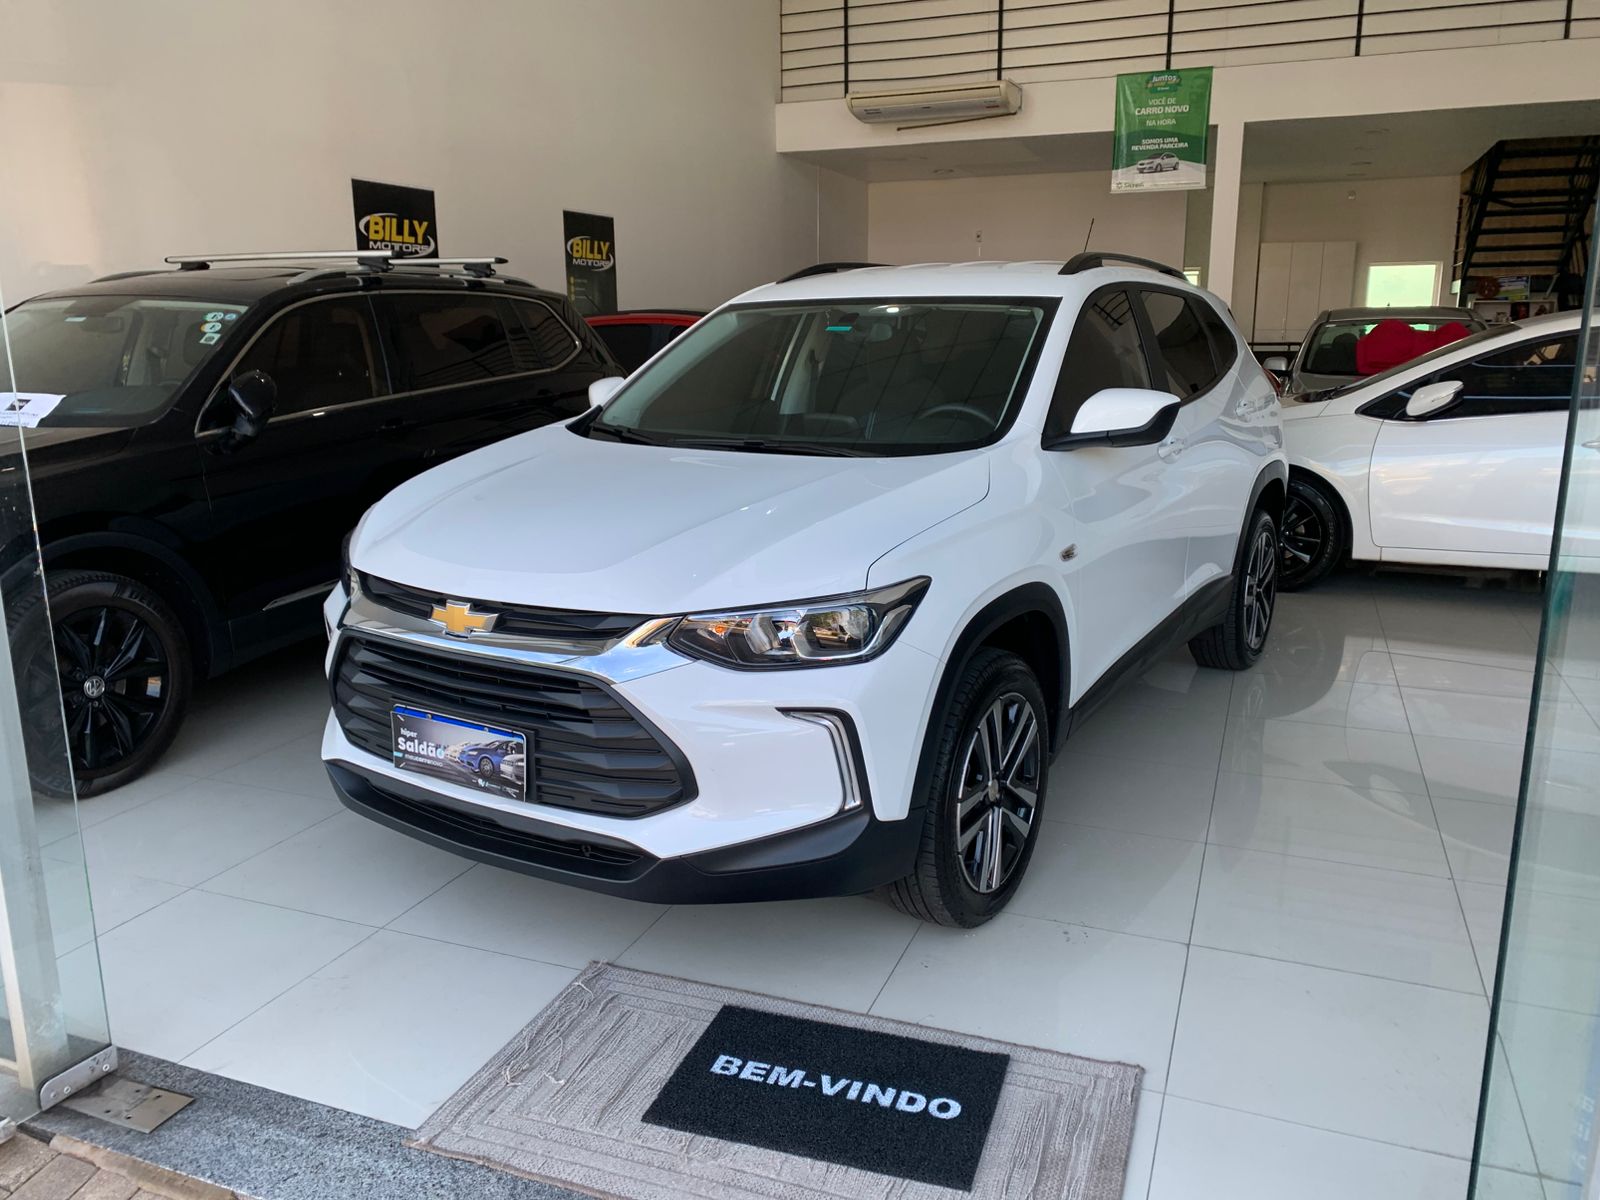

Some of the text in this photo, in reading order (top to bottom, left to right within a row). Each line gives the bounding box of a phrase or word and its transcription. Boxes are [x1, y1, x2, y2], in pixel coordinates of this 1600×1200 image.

[1135, 105, 1190, 115] CARRO NOVO
[1148, 97, 1166, 106] VOCÊ
[1157, 118, 1176, 126] HORA
[369, 215, 429, 244] BILLY
[572, 239, 610, 260] BILLY
[397, 736, 445, 759] Saldão
[710, 1054, 962, 1120] BEM-VINDO
